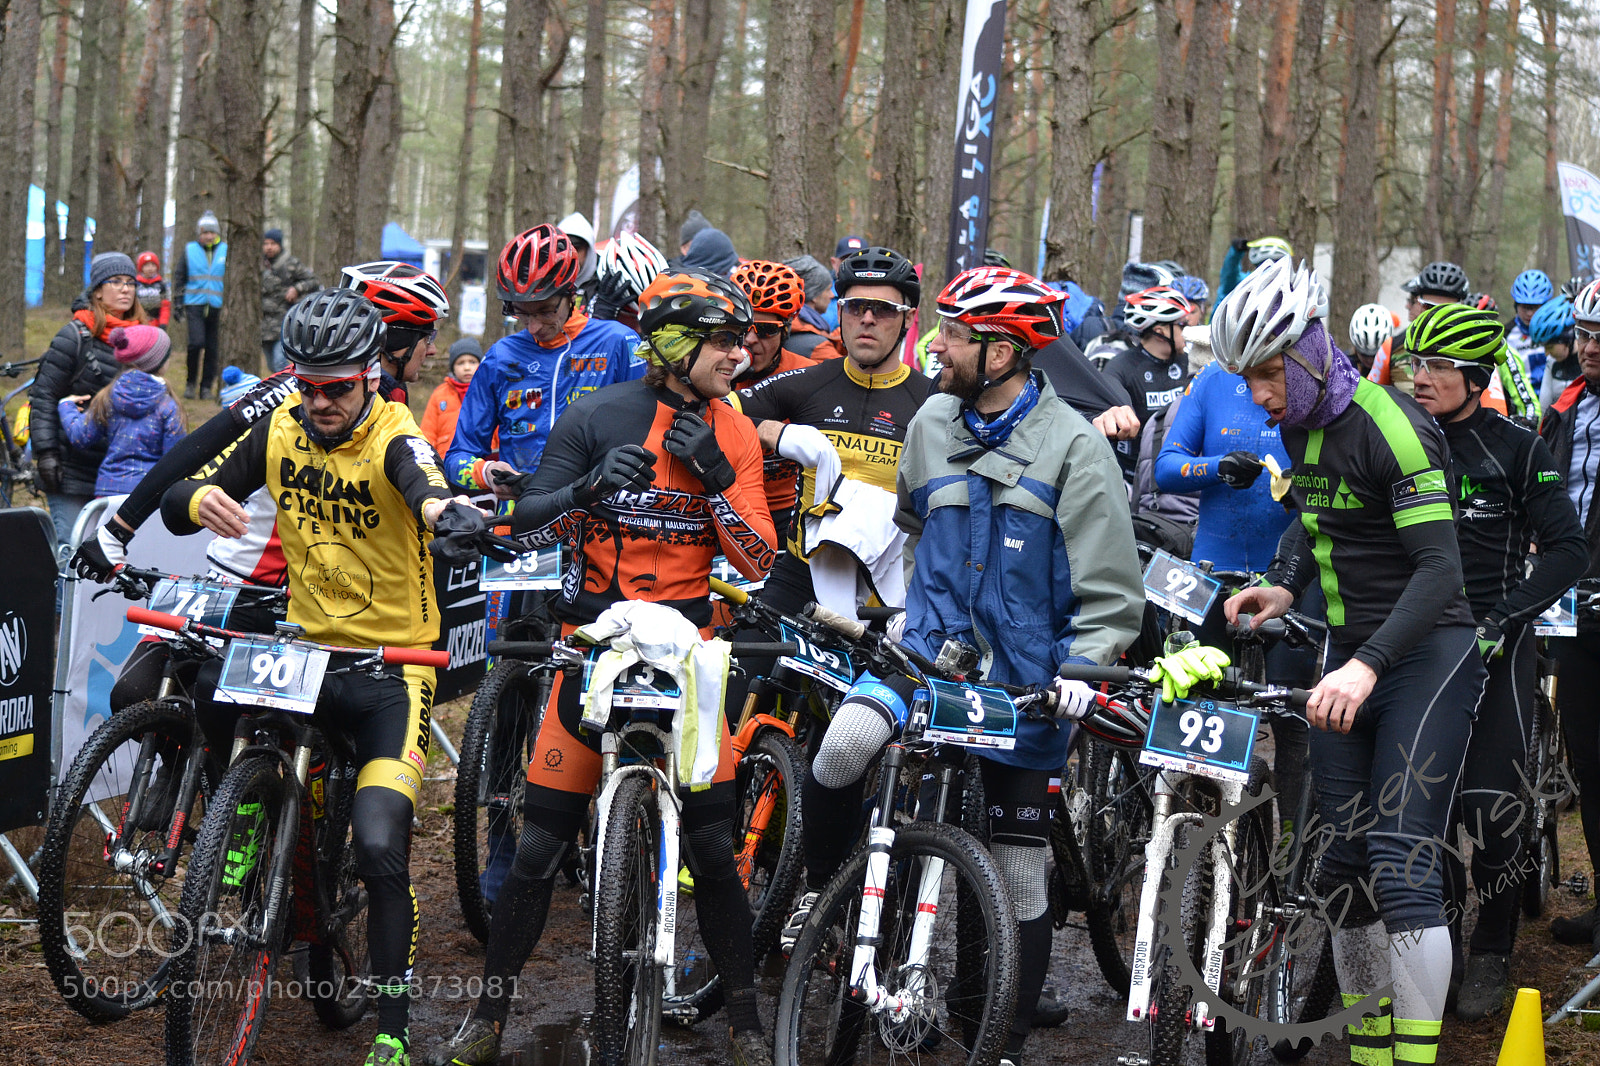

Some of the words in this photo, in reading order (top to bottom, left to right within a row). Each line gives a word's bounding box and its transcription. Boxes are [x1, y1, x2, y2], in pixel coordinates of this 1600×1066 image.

[698, 316, 727, 325] catlike
[753, 368, 807, 391] RENAULT
[826, 434, 904, 459] ENAULT
[865, 453, 897, 467] TEAM
[1192, 463, 1209, 476] IGT
[602, 489, 714, 518] REZAD
[296, 516, 367, 540] TEAM
[1164, 567, 1198, 601] 92
[1282, 554, 1301, 586] KIPSTA
[169, 590, 211, 622] 74
[794, 633, 840, 670] 109
[251, 652, 296, 688] 90
[964, 689, 986, 724] 3
[1178, 709, 1225, 754] 93
[664, 890, 676, 934] ROCKSHOX
[1132, 940, 1148, 987] ROCKSHOX
[1207, 949, 1223, 996] OCKSHOX
